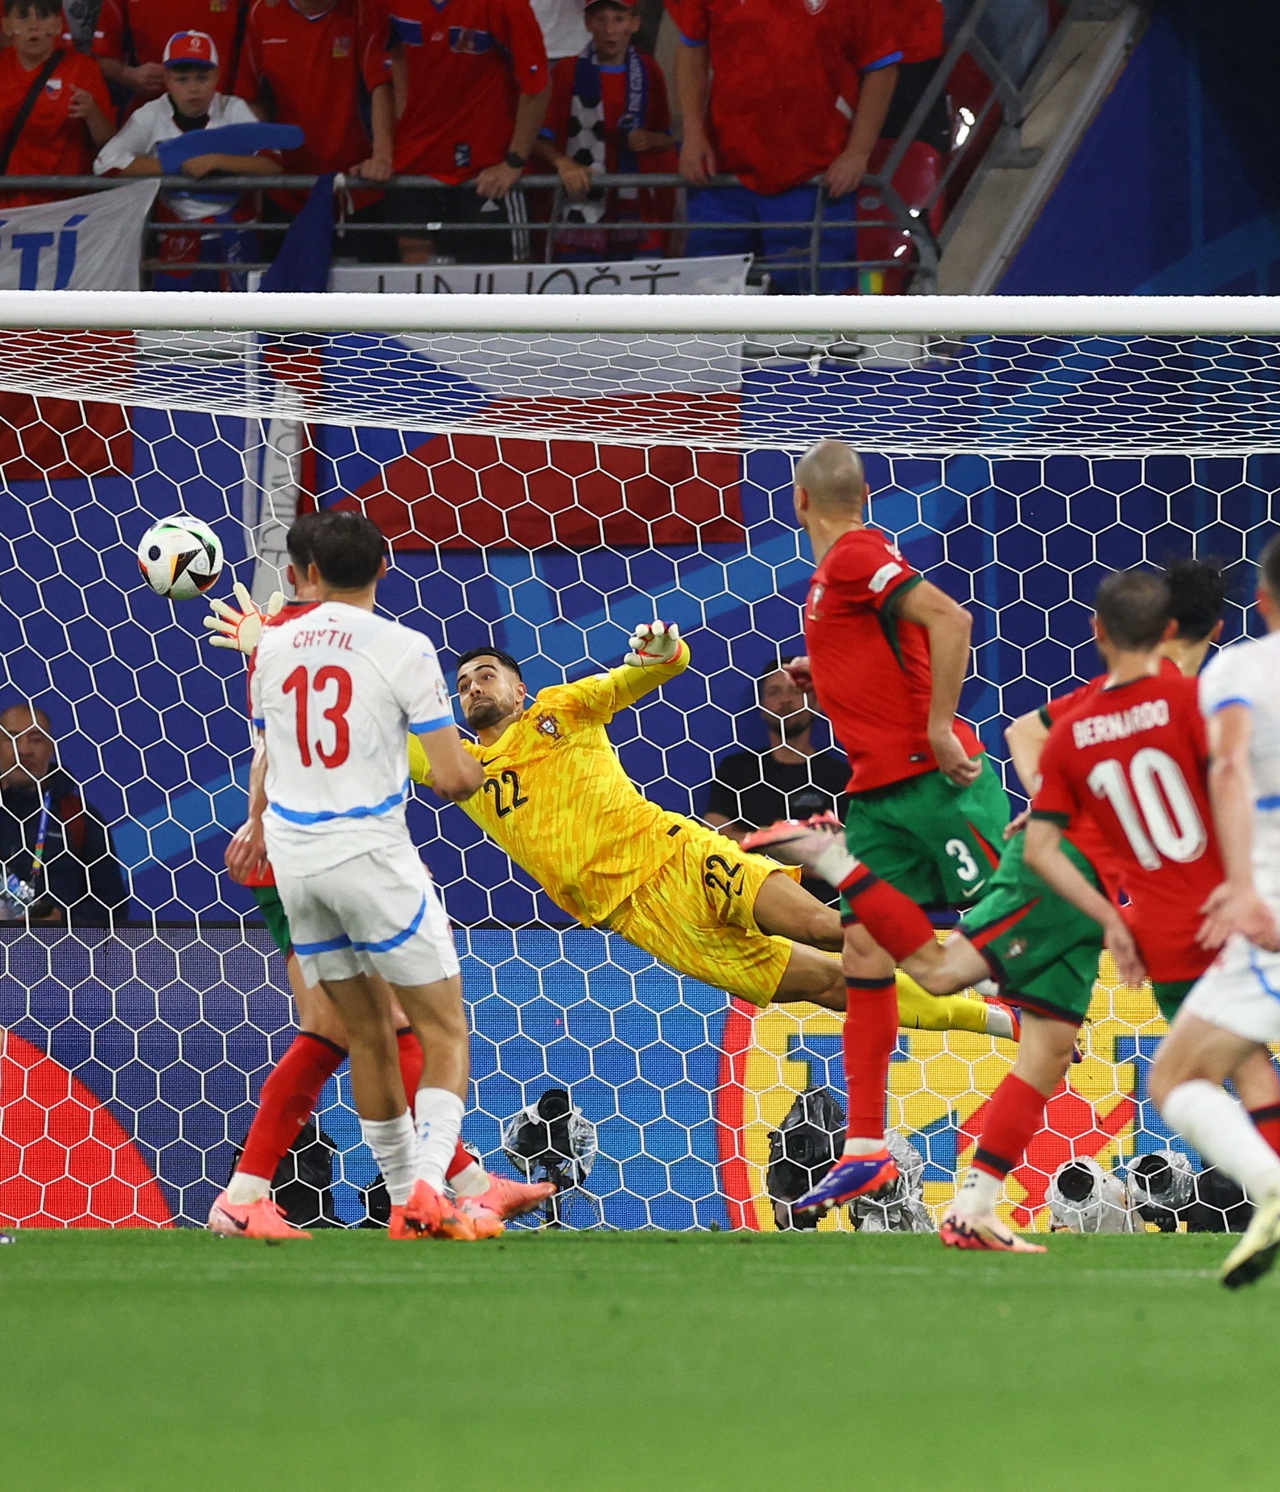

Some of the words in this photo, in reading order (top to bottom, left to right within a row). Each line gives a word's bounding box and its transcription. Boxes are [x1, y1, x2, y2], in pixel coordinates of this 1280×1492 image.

[0, 214, 89, 290] TÍ
[293, 629, 353, 650] CHYTIL
[282, 665, 353, 769] 13
[1071, 698, 1170, 750] BERNARDO
[483, 769, 530, 820] 22
[1086, 746, 1208, 872] 10
[705, 854, 743, 898] 22
[945, 838, 980, 882] 3
